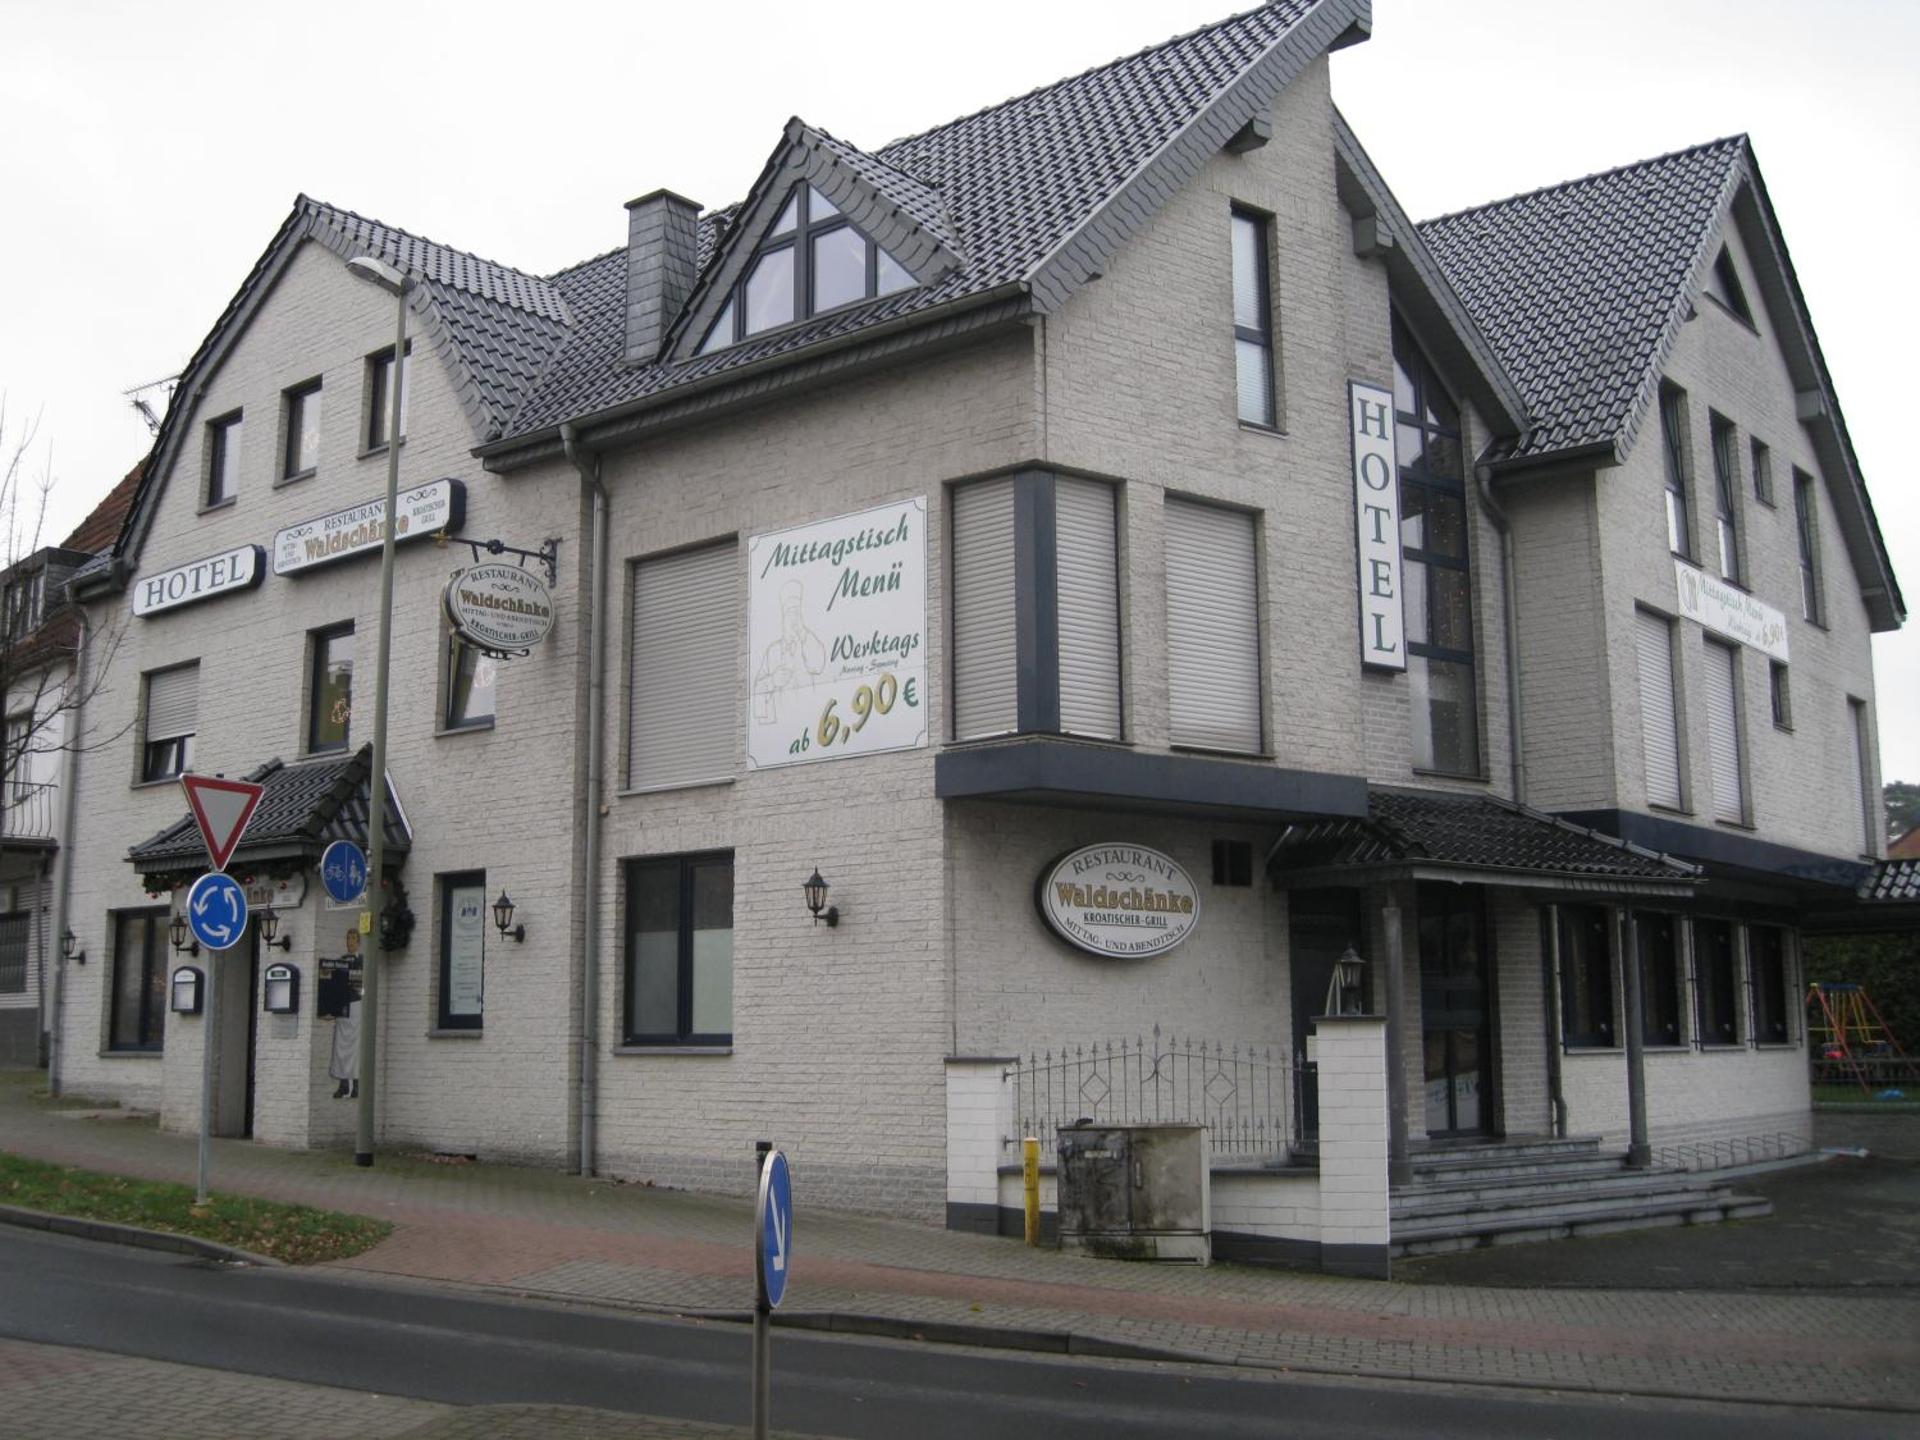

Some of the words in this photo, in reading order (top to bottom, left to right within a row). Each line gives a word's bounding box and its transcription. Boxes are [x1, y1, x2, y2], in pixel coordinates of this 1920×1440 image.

[324, 499, 387, 531] RESTAURAN
[1358, 397, 1397, 653] HOTEL
[305, 513, 409, 561] Waldschäne
[761, 513, 909, 580] Mittagstisch
[144, 554, 246, 609] HOTEL
[470, 568, 540, 593] RESTAURANT
[826, 560, 904, 613] Menü
[460, 588, 550, 619] Waldschänke
[830, 630, 919, 663] Werktags
[788, 728, 810, 755] ab
[1071, 849, 1177, 881] RESTAURANT
[1054, 881, 1194, 915] Waldschänke
[1105, 939, 1128, 950] UND
